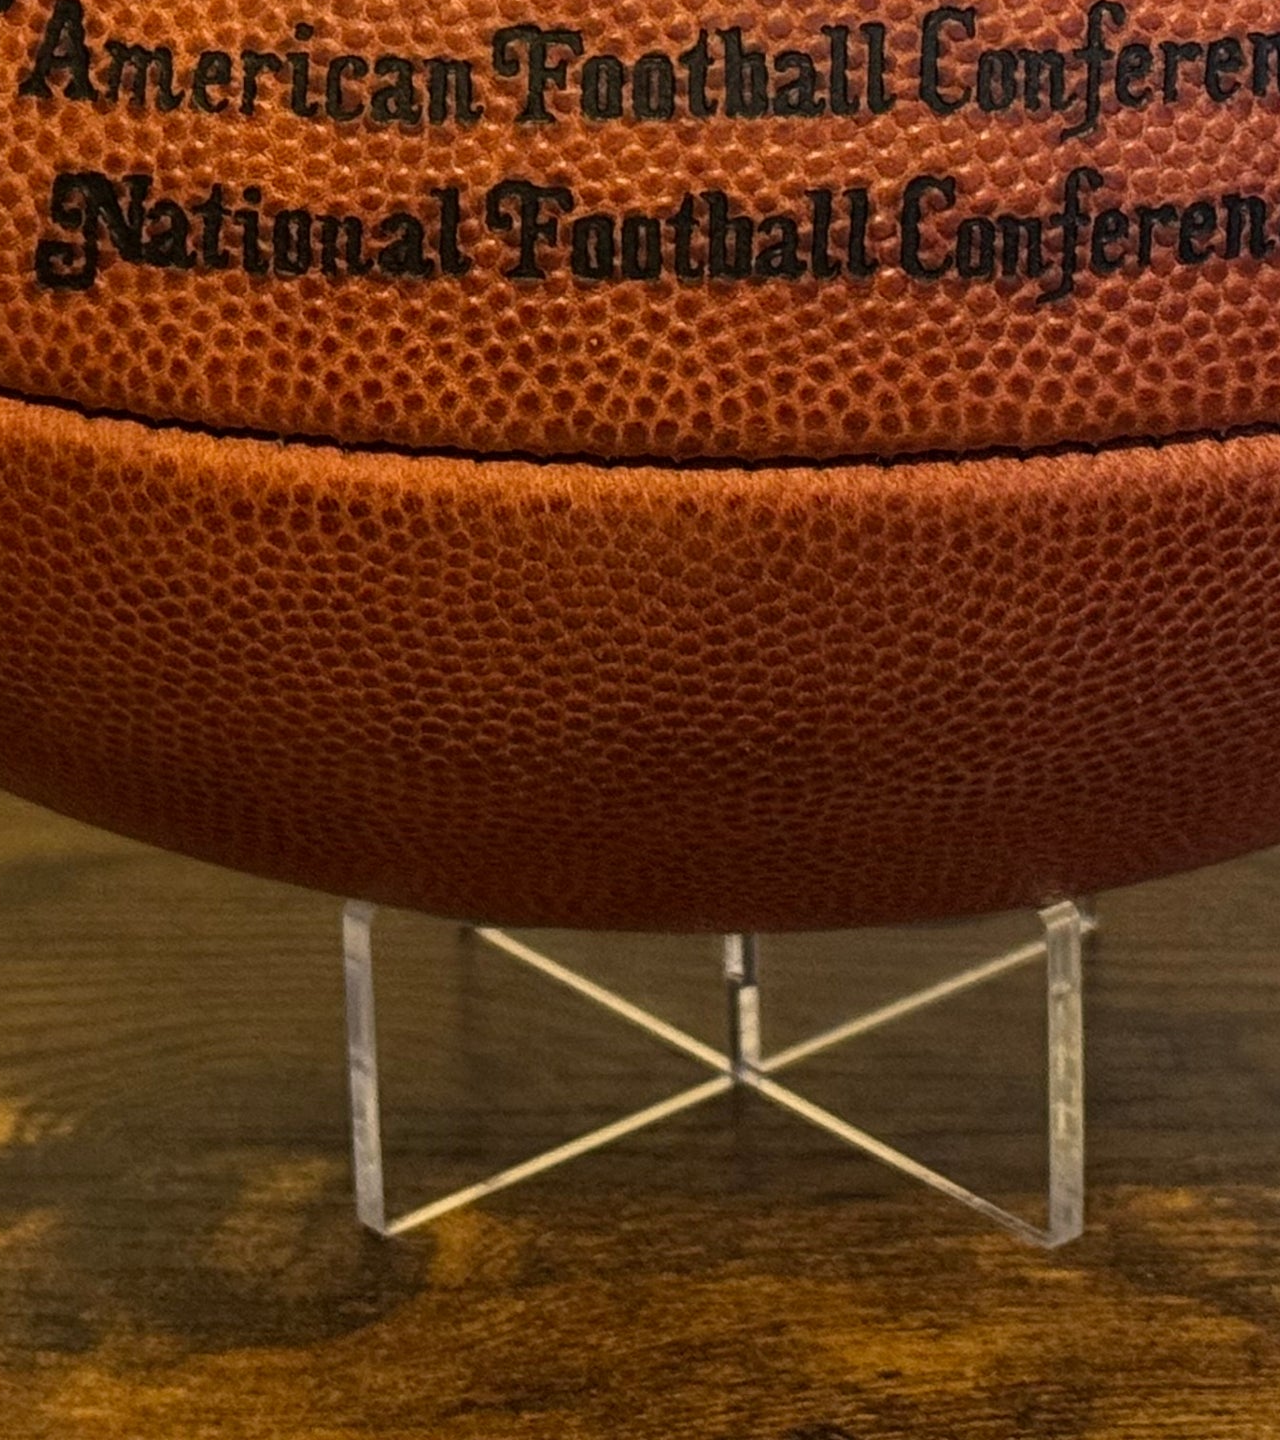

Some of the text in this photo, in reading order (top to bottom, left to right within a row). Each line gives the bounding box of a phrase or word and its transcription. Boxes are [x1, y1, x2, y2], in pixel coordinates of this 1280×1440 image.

[492, 23, 895, 123] Football
[35, 171, 472, 291] National
[487, 179, 876, 281] Football
